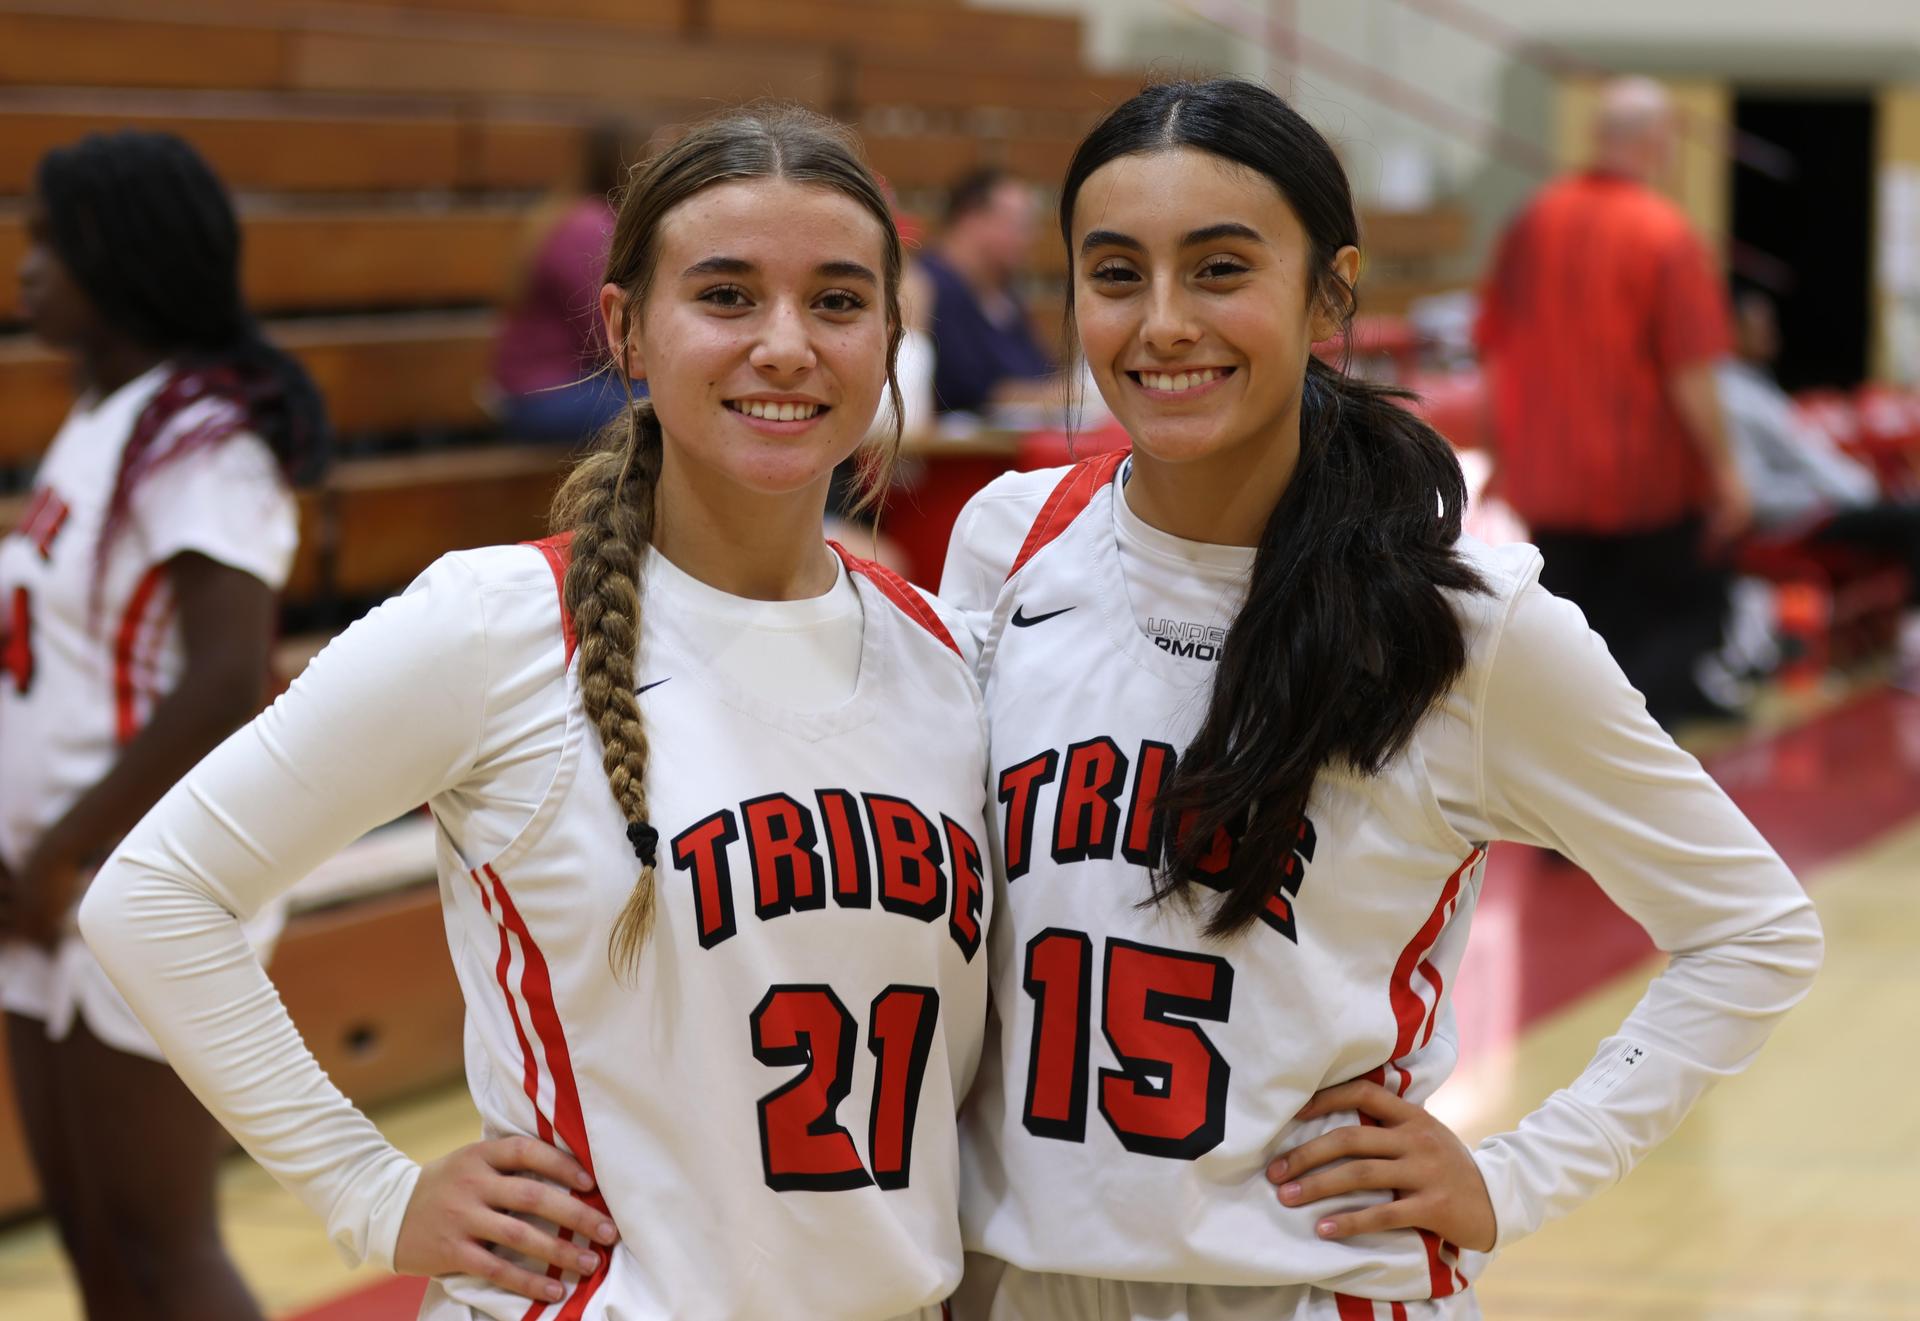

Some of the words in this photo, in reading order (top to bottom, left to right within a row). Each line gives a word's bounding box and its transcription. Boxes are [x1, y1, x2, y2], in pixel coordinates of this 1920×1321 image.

[1145, 634, 1222, 661] RMO
[1147, 617, 1228, 643] UNDE
[671, 788, 984, 964] TRIBE
[749, 983, 940, 1193] 21
[1023, 926, 1235, 1161] 15
